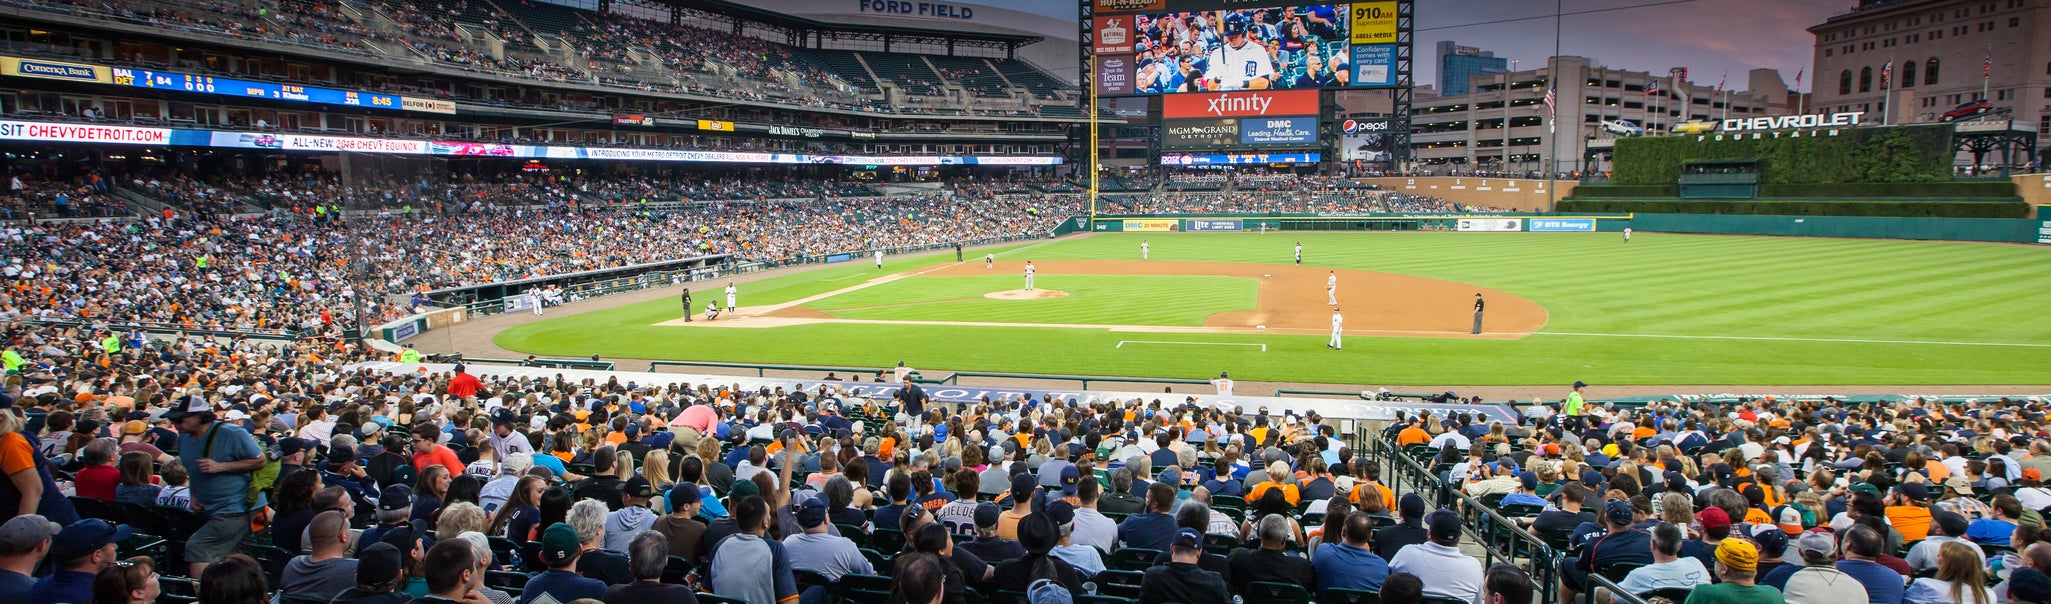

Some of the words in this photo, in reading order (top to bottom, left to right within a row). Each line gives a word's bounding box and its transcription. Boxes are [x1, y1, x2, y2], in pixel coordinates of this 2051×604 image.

[860, 0, 912, 14] FORD
[918, 2, 973, 19] FIELD
[1356, 8, 1380, 19] 910
[68, 67, 91, 77] Bank
[113, 68, 135, 78] BAL
[1102, 72, 1125, 82] Team
[114, 77, 134, 85] DET
[372, 96, 392, 106] 8:45
[1208, 94, 1272, 116] xfinity
[1267, 120, 1292, 128] DMC
[1358, 121, 1388, 132] pepsi
[1722, 112, 1865, 132] CHEVROLET
[29, 125, 163, 142] CHEVYDETROIT.COM
[768, 125, 780, 135] JACK
[1168, 126, 1192, 134] MGM
[1203, 126, 1235, 134] GRAND
[1698, 130, 1839, 142] FOUNTAIN
[292, 138, 334, 148] ALL-NEW
[336, 139, 354, 149] 2018
[357, 140, 383, 150] CHEVY
[386, 142, 417, 151] EQUINOX
[592, 150, 630, 158] INTRODUCING
[1194, 220, 1210, 230] Lite
